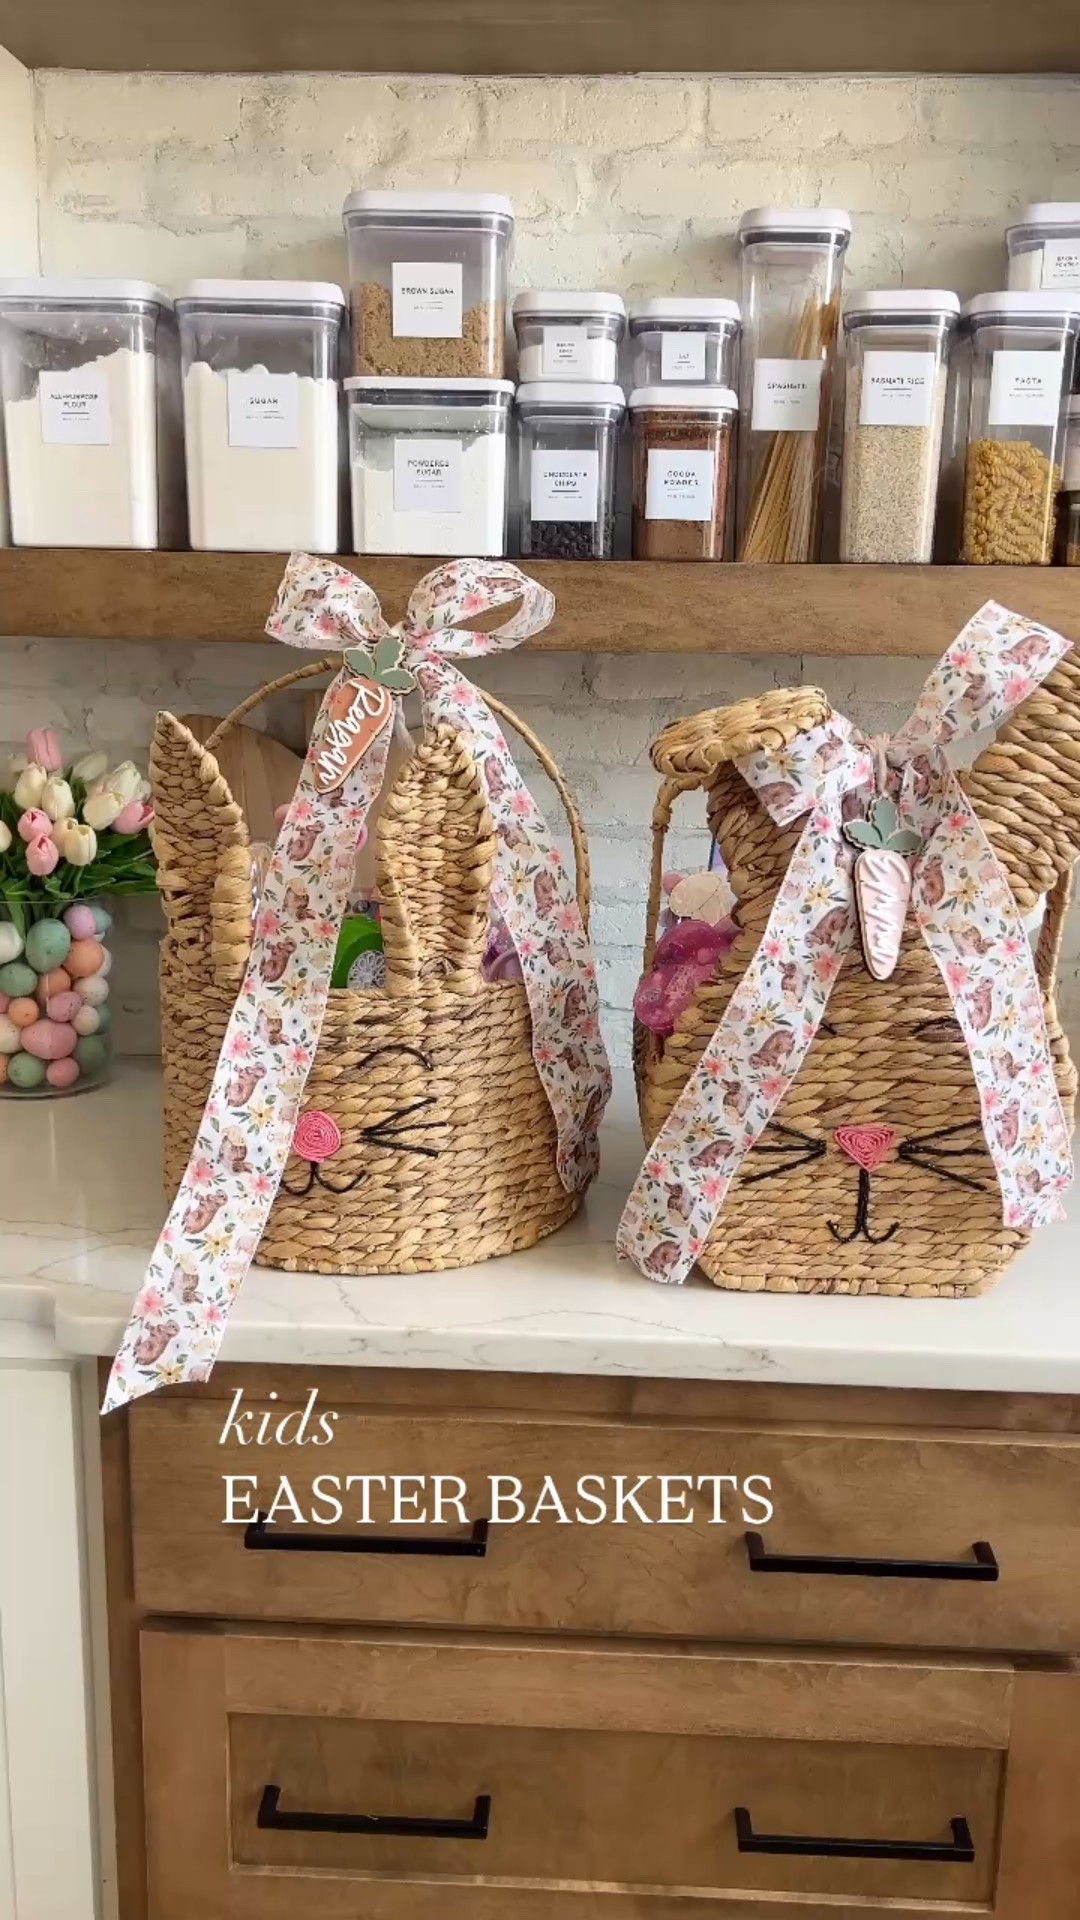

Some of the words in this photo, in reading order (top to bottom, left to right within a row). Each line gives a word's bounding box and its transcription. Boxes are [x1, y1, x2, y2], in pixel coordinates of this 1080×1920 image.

[401, 287, 427, 295] BROWN
[429, 287, 455, 295] SUGAR
[1015, 377, 1042, 385] PASTA
[249, 397, 279, 405] SUGAR
[667, 470, 696, 478] COCOA
[318, 680, 385, 786] Reagan
